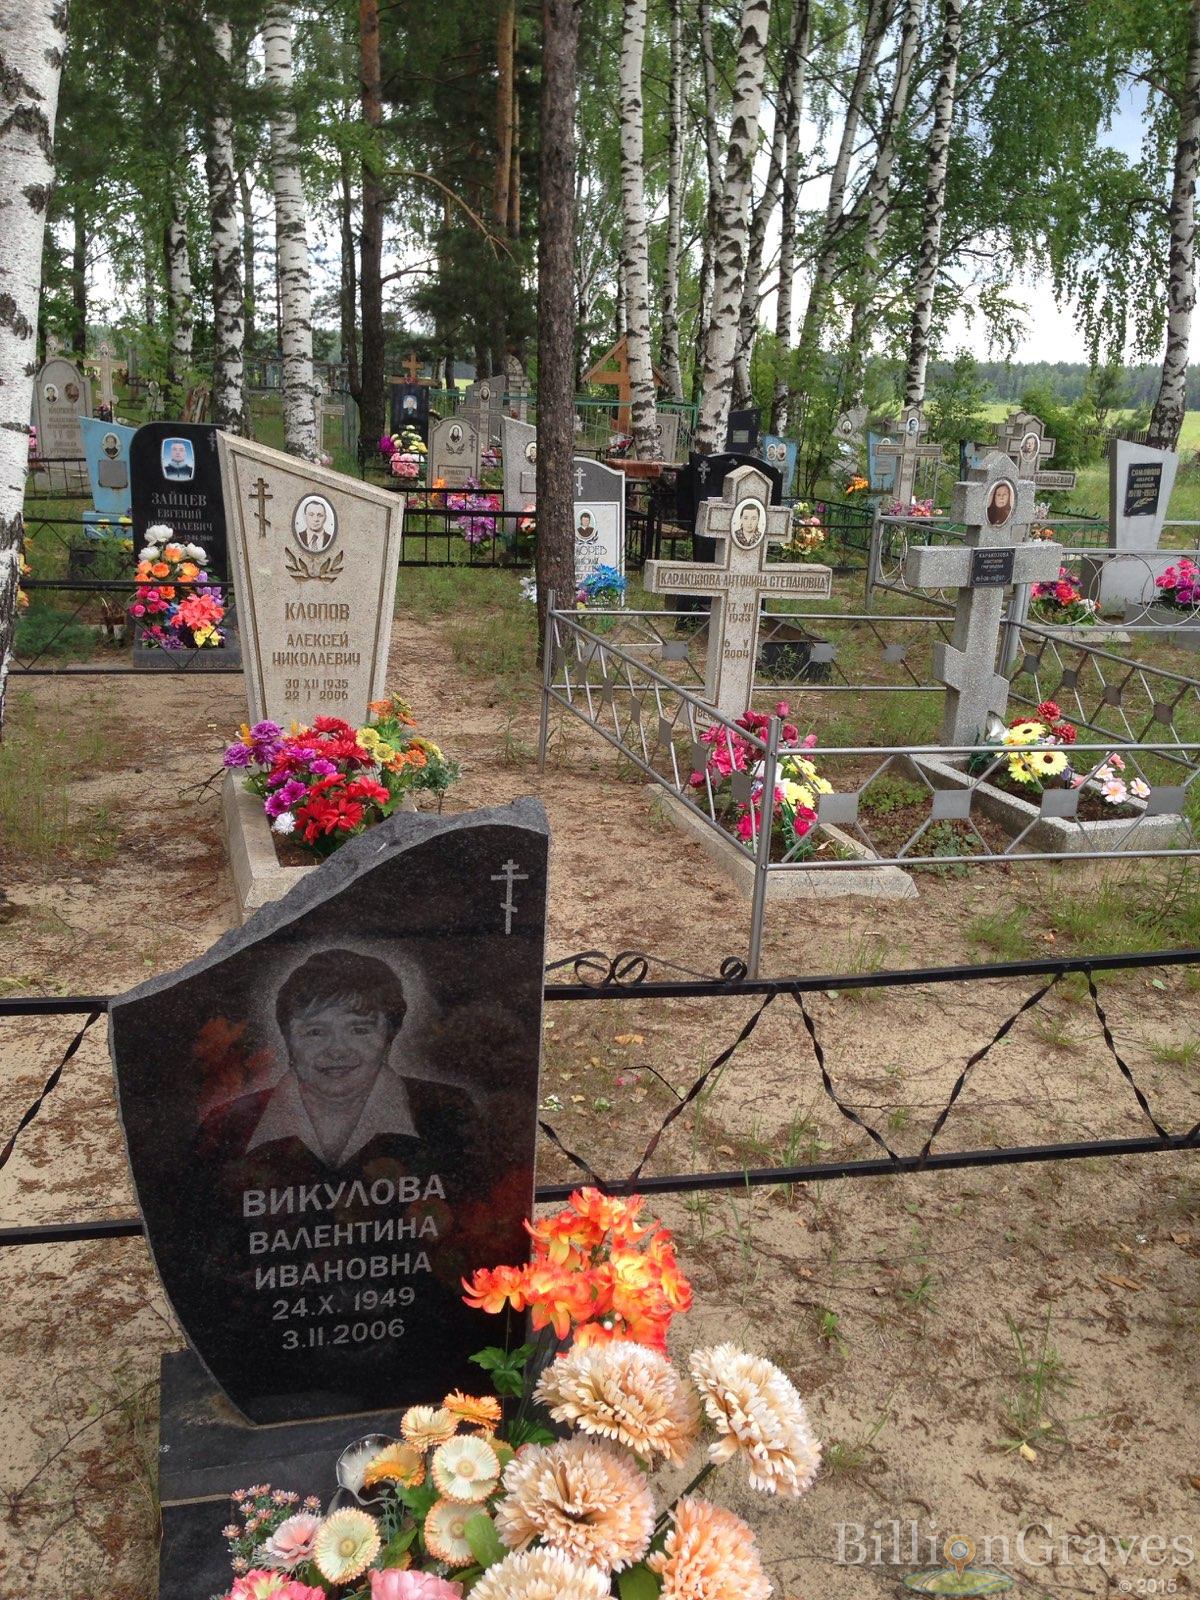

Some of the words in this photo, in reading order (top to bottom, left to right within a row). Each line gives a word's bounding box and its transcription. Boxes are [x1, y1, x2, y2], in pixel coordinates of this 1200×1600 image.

[151, 491, 207, 507] ЗАЙЦЕВ
[157, 508, 202, 519] ЕВГЕНИЙ
[660, 573, 721, 586] КАРАКОЗОВА
[723, 574, 767, 587] АНТОНИНА
[769, 576, 825, 589] СТЕПАНОВНА
[285, 602, 350, 621] КЛОПОВ
[729, 613, 751, 622] 1933
[287, 631, 349, 648] АЛЕКСЕЙ
[724, 639, 731, 648] 6
[272, 652, 361, 666] НИКОЛАЕВИЧ
[724, 649, 749, 659] 2004
[285, 679, 299, 689] 30
[323, 678, 349, 689] 1935
[285, 690, 299, 700] 22
[319, 690, 349, 700] 2006
[243, 1174, 446, 1218] ВИКУЛОВА
[249, 1215, 439, 1255] ВАЛЕНТИНА
[255, 1251, 433, 1290] ИВАНОВНА
[354, 1286, 416, 1311] 1949
